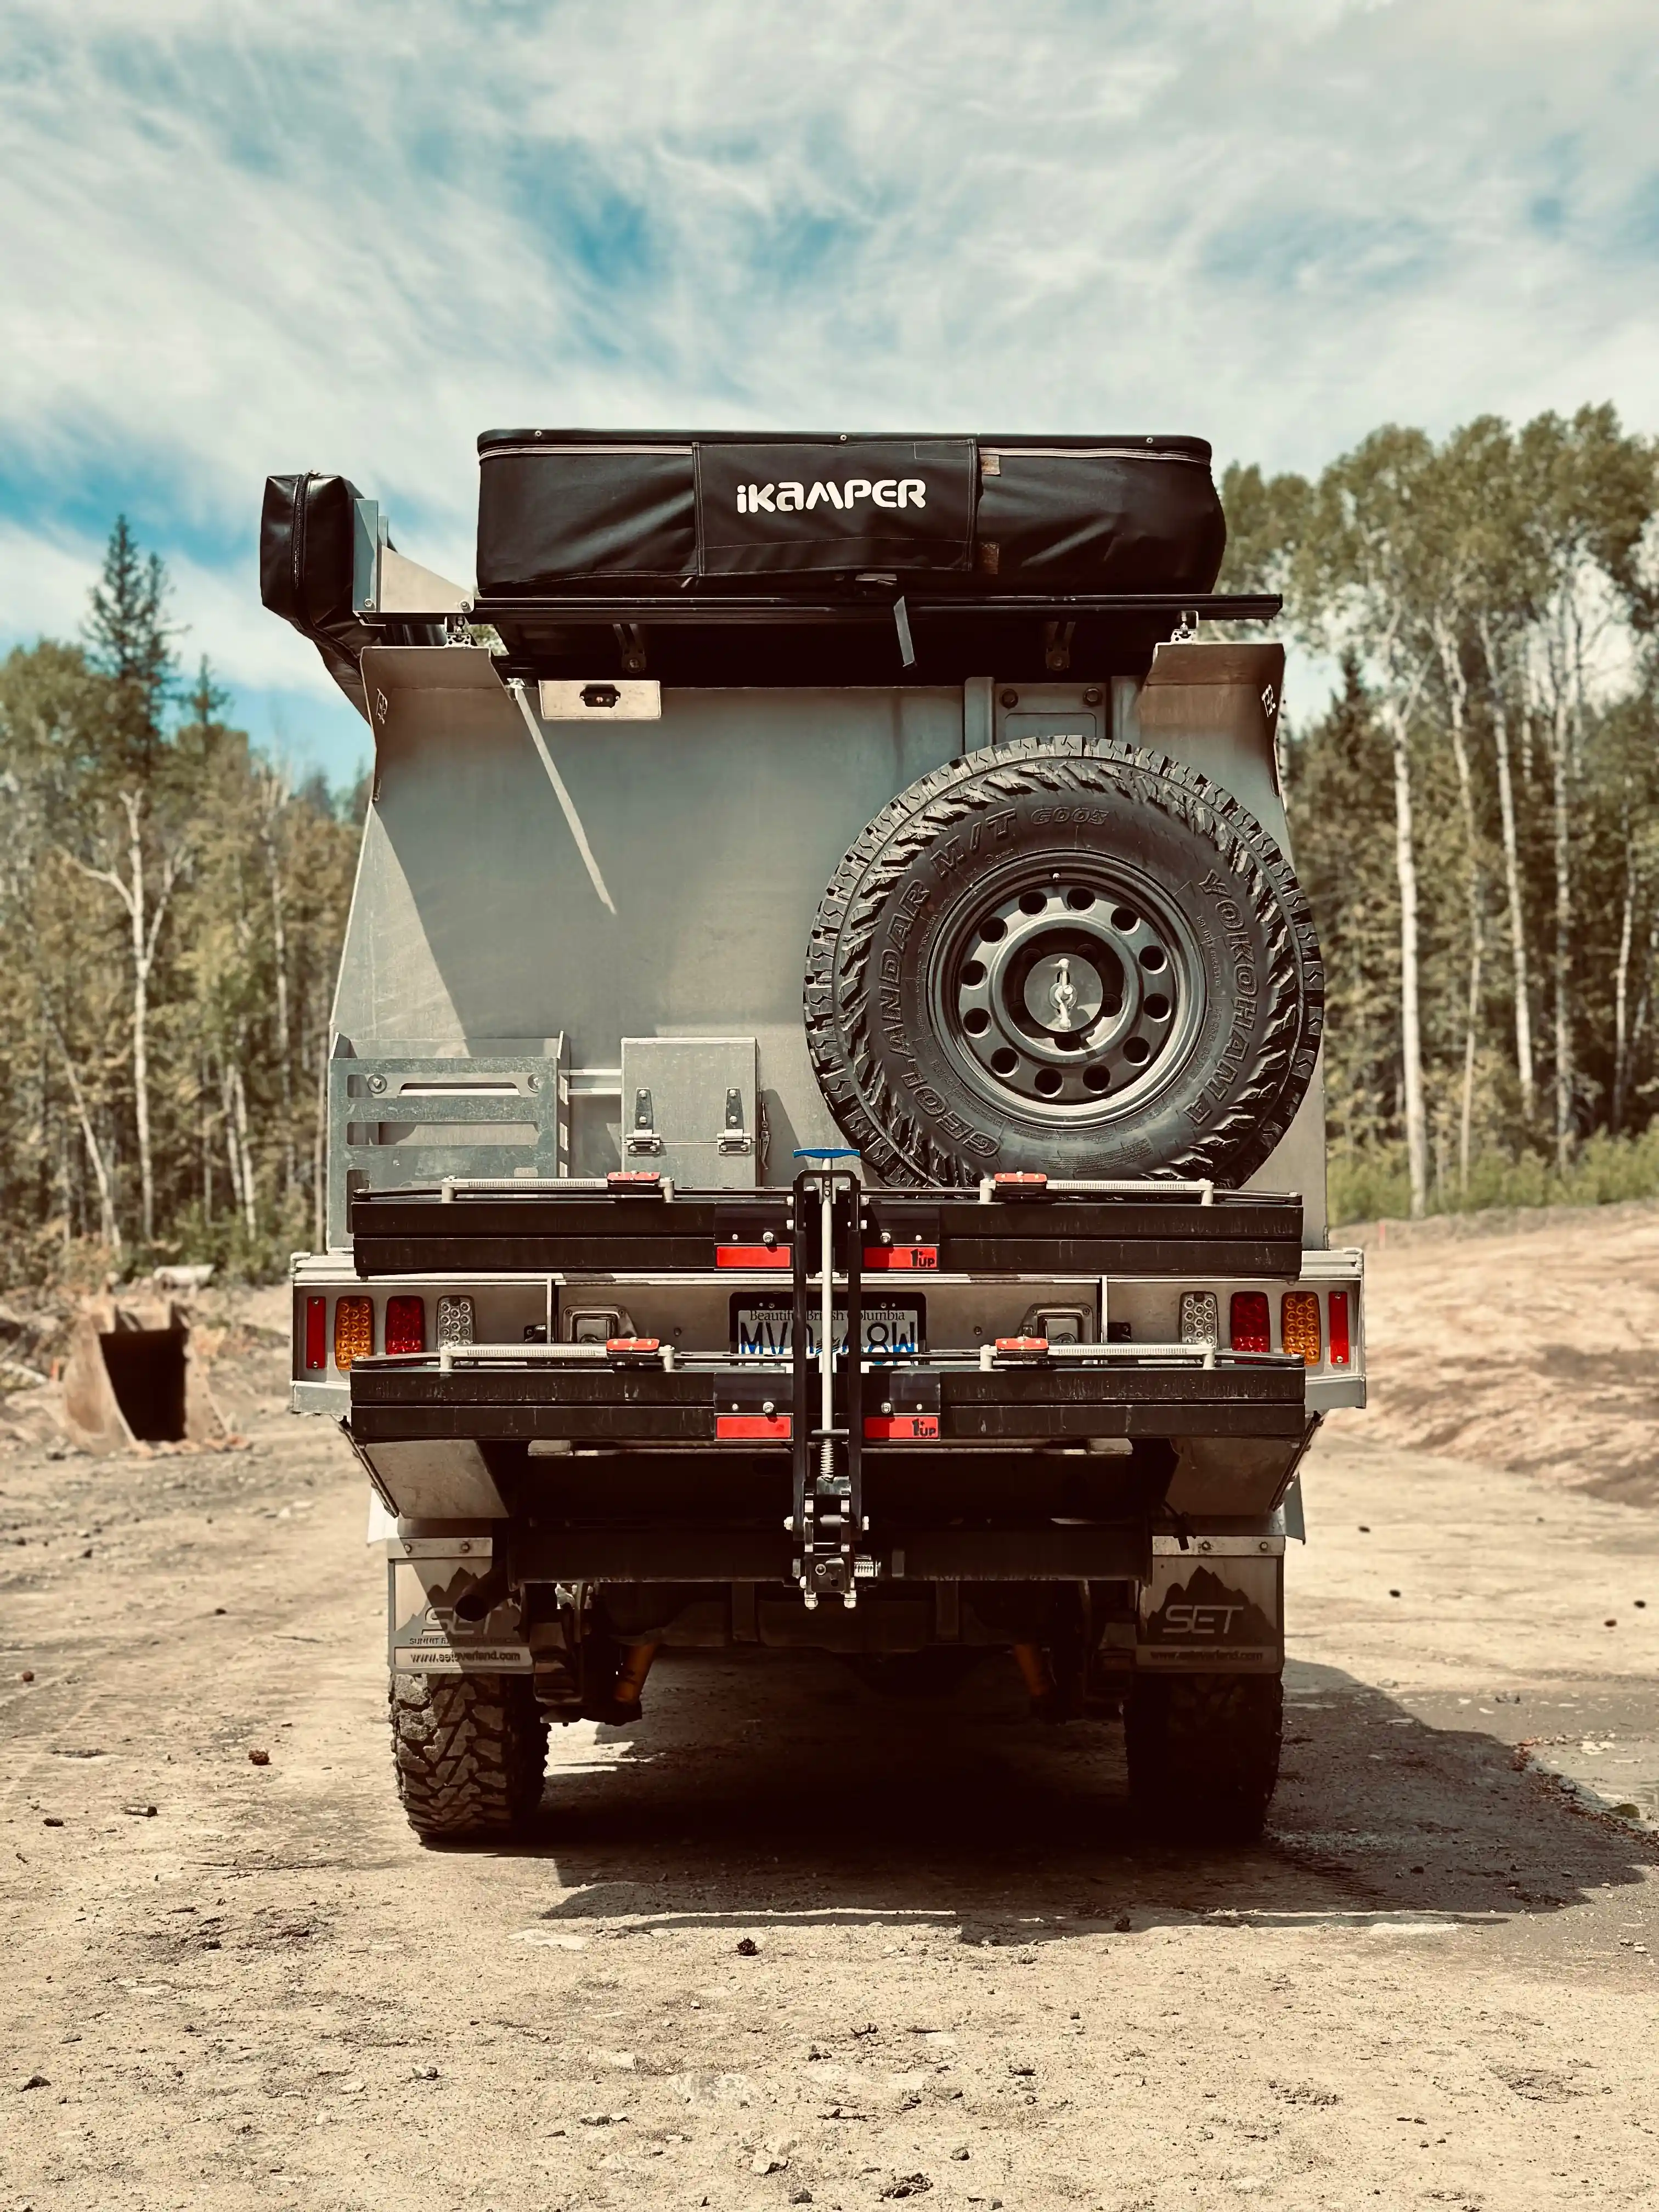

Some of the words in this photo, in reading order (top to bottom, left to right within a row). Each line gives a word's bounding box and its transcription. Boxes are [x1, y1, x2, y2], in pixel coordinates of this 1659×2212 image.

[879, 880, 1000, 1156] GEOLANDAR
[1184, 869, 1257, 1124] YOKOHAMA
[750, 1310, 793, 1321] Beautif
[807, 1310, 844, 1321] Brish
[861, 1310, 905, 1321] lumbia
